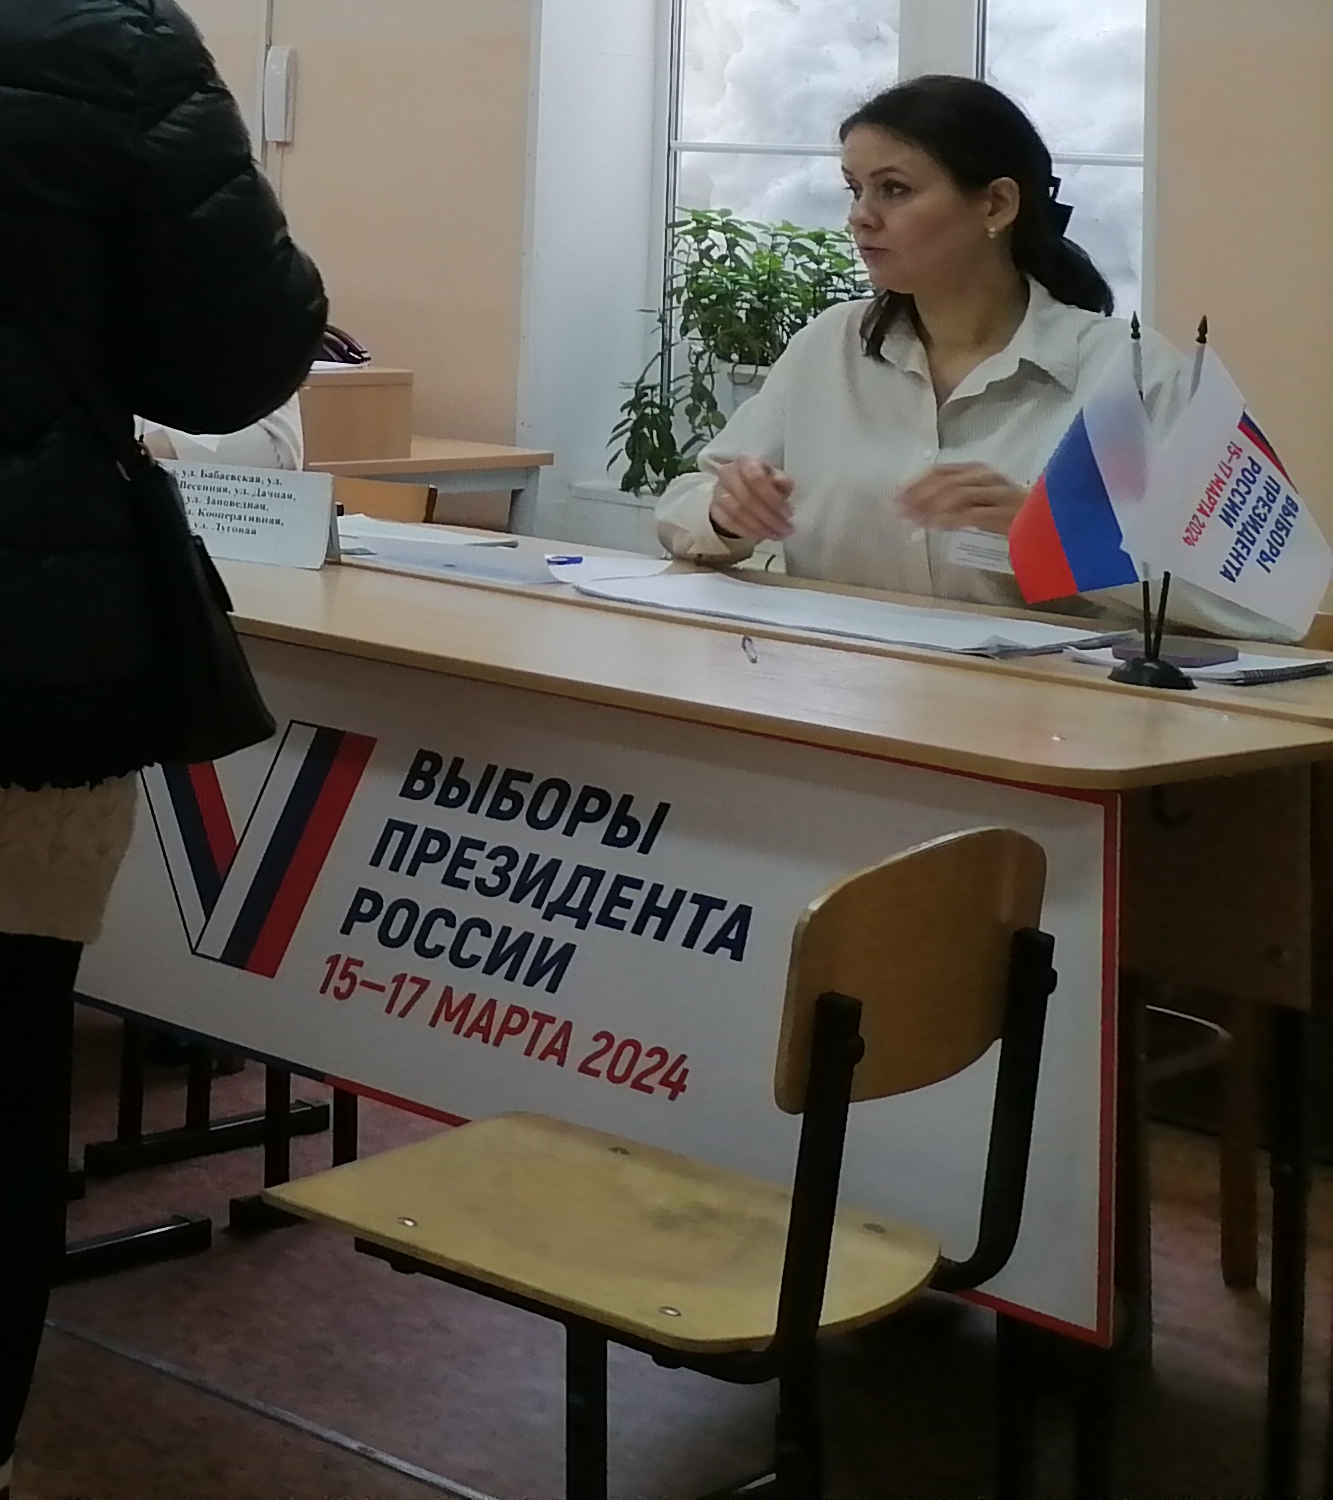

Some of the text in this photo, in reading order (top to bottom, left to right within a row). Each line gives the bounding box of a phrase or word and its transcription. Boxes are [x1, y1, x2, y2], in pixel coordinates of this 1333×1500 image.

[1182, 513, 1206, 547] 2024
[1196, 473, 1227, 518] МАРТА
[1218, 456, 1262, 529] РОССИИ
[1219, 475, 1281, 583] ПРЕЗИДЕНТА
[1256, 494, 1300, 574] ВЫБОРЫ
[398, 748, 672, 855] ВЫБОРЫ
[339, 886, 578, 995] РОССИИ
[368, 817, 754, 963] ПРЕЗИДЕНТА
[318, 953, 690, 1102] 15–17 МАРТА 2024
